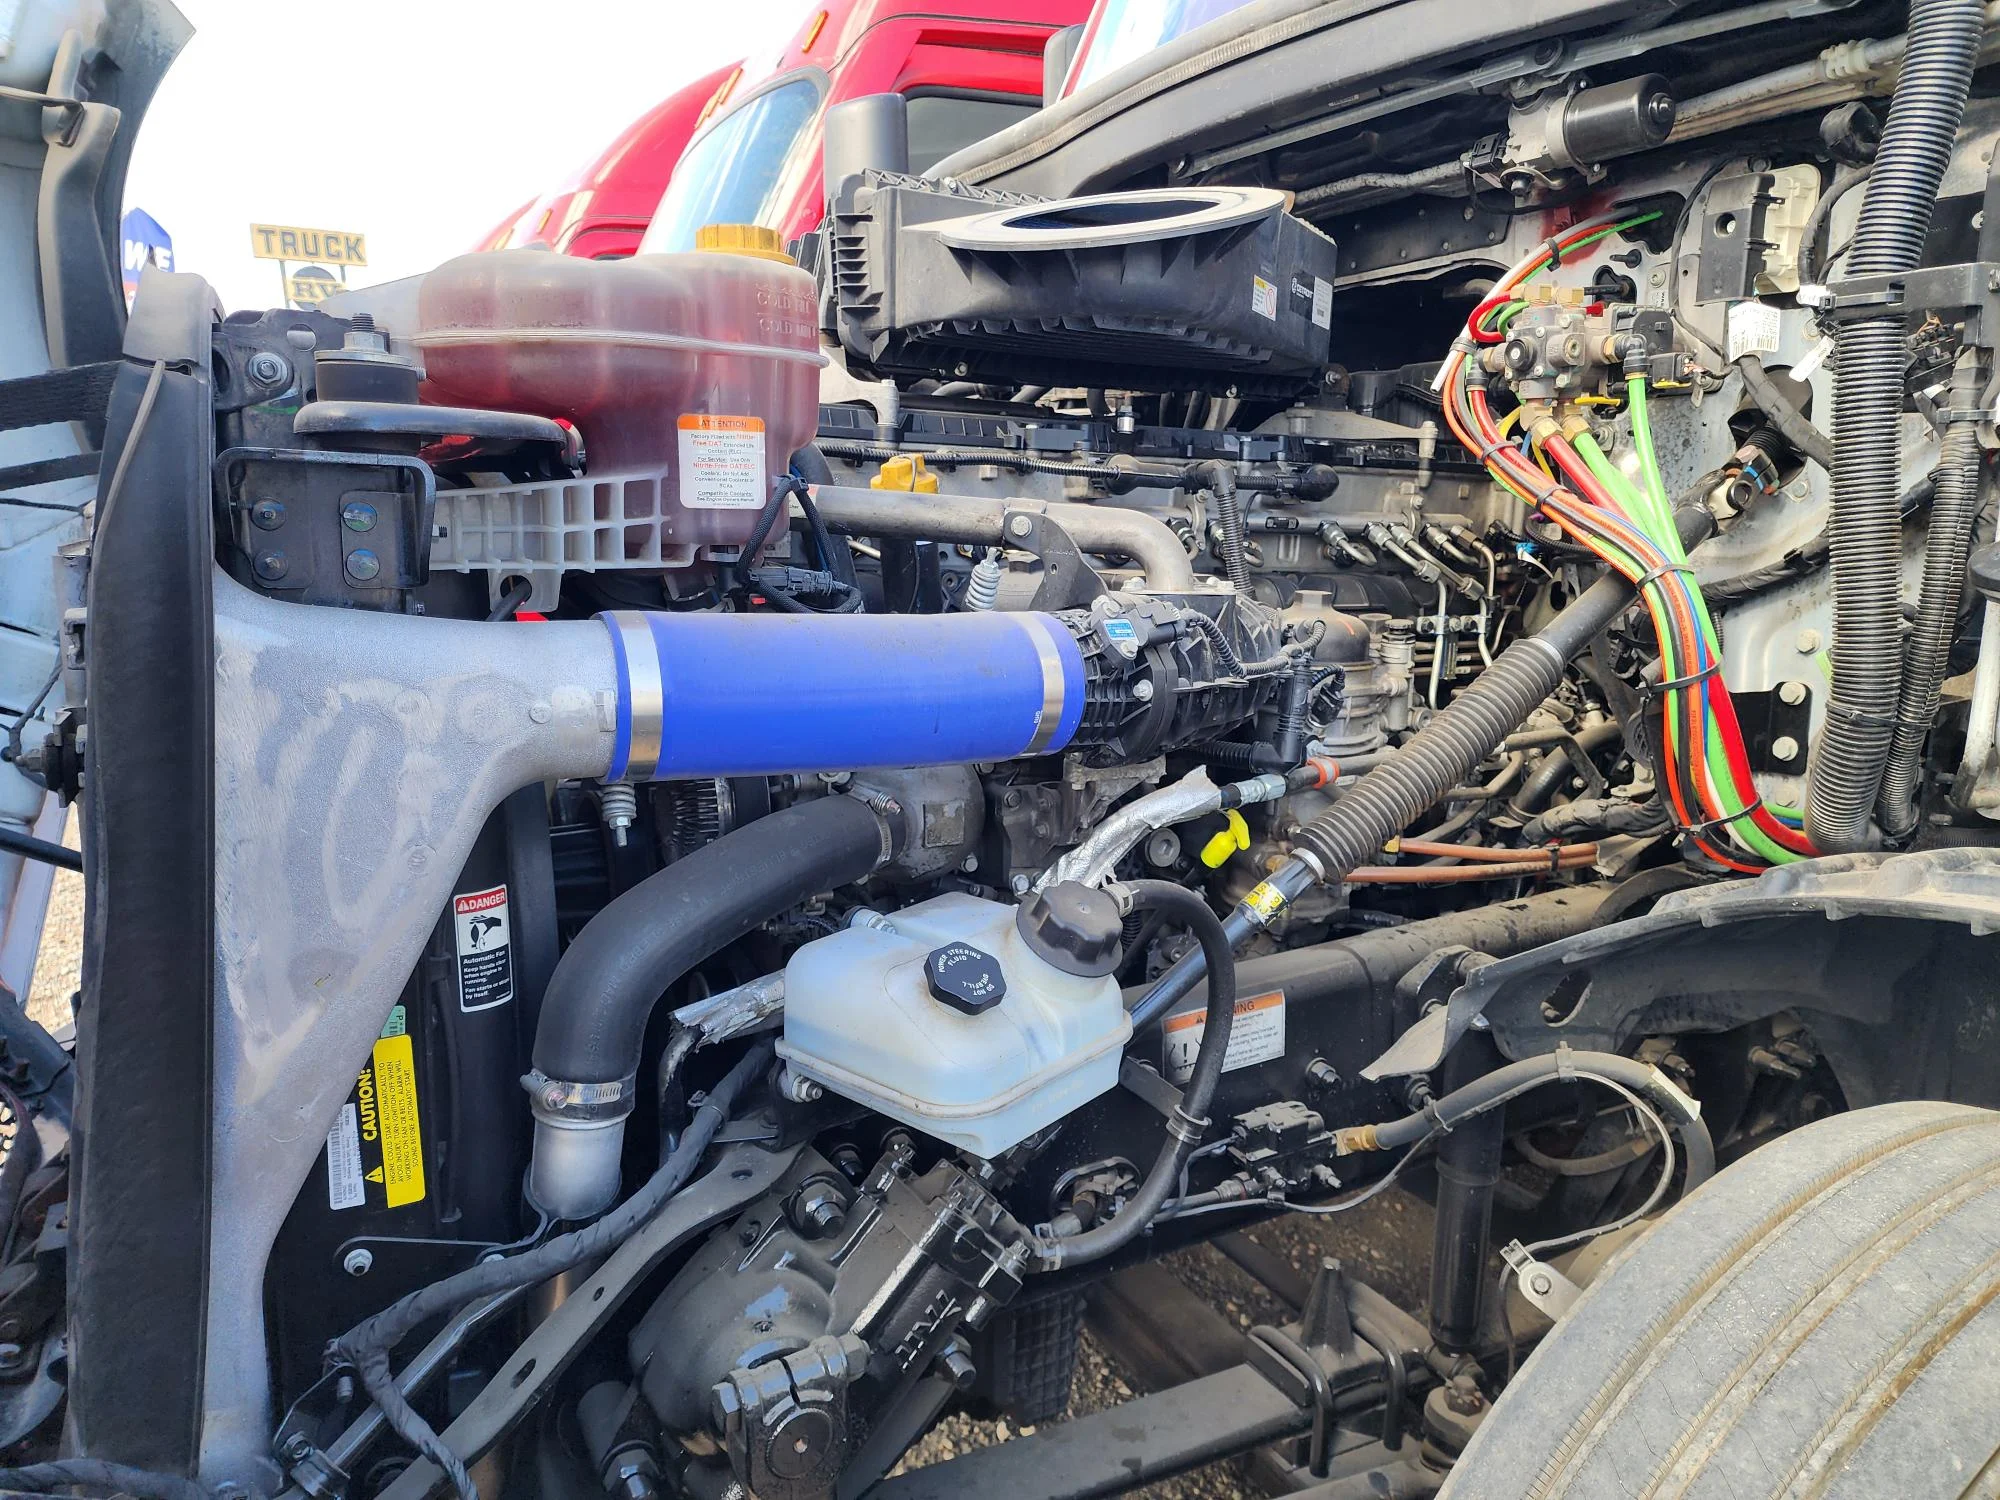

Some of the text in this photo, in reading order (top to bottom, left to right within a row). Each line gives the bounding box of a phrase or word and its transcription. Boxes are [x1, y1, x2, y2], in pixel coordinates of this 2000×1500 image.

[257, 228, 365, 262] TRUCK
[293, 280, 343, 298] RV
[701, 420, 747, 428] ATTENTION
[468, 892, 506, 910] DANGER
[463, 954, 495, 964] Automatic
[938, 948, 982, 973] POWER STEERING
[948, 955, 967, 966] FLUID
[962, 973, 989, 989] OVERFILL
[1233, 1001, 1255, 1014] NING
[378, 1062, 386, 1072] TO
[358, 1068, 378, 1141] CAUTION:
[390, 1094, 398, 1121] IGNITION
[406, 1087, 414, 1121] AUTOMATIC
[399, 1116, 407, 1124] OR
[408, 1123, 416, 1144] BEFORE
[402, 1140, 409, 1149] ON
[410, 1145, 419, 1167] SOUND
[388, 1163, 396, 1184] ENGINE
[403, 1152, 412, 1180] WORKING
